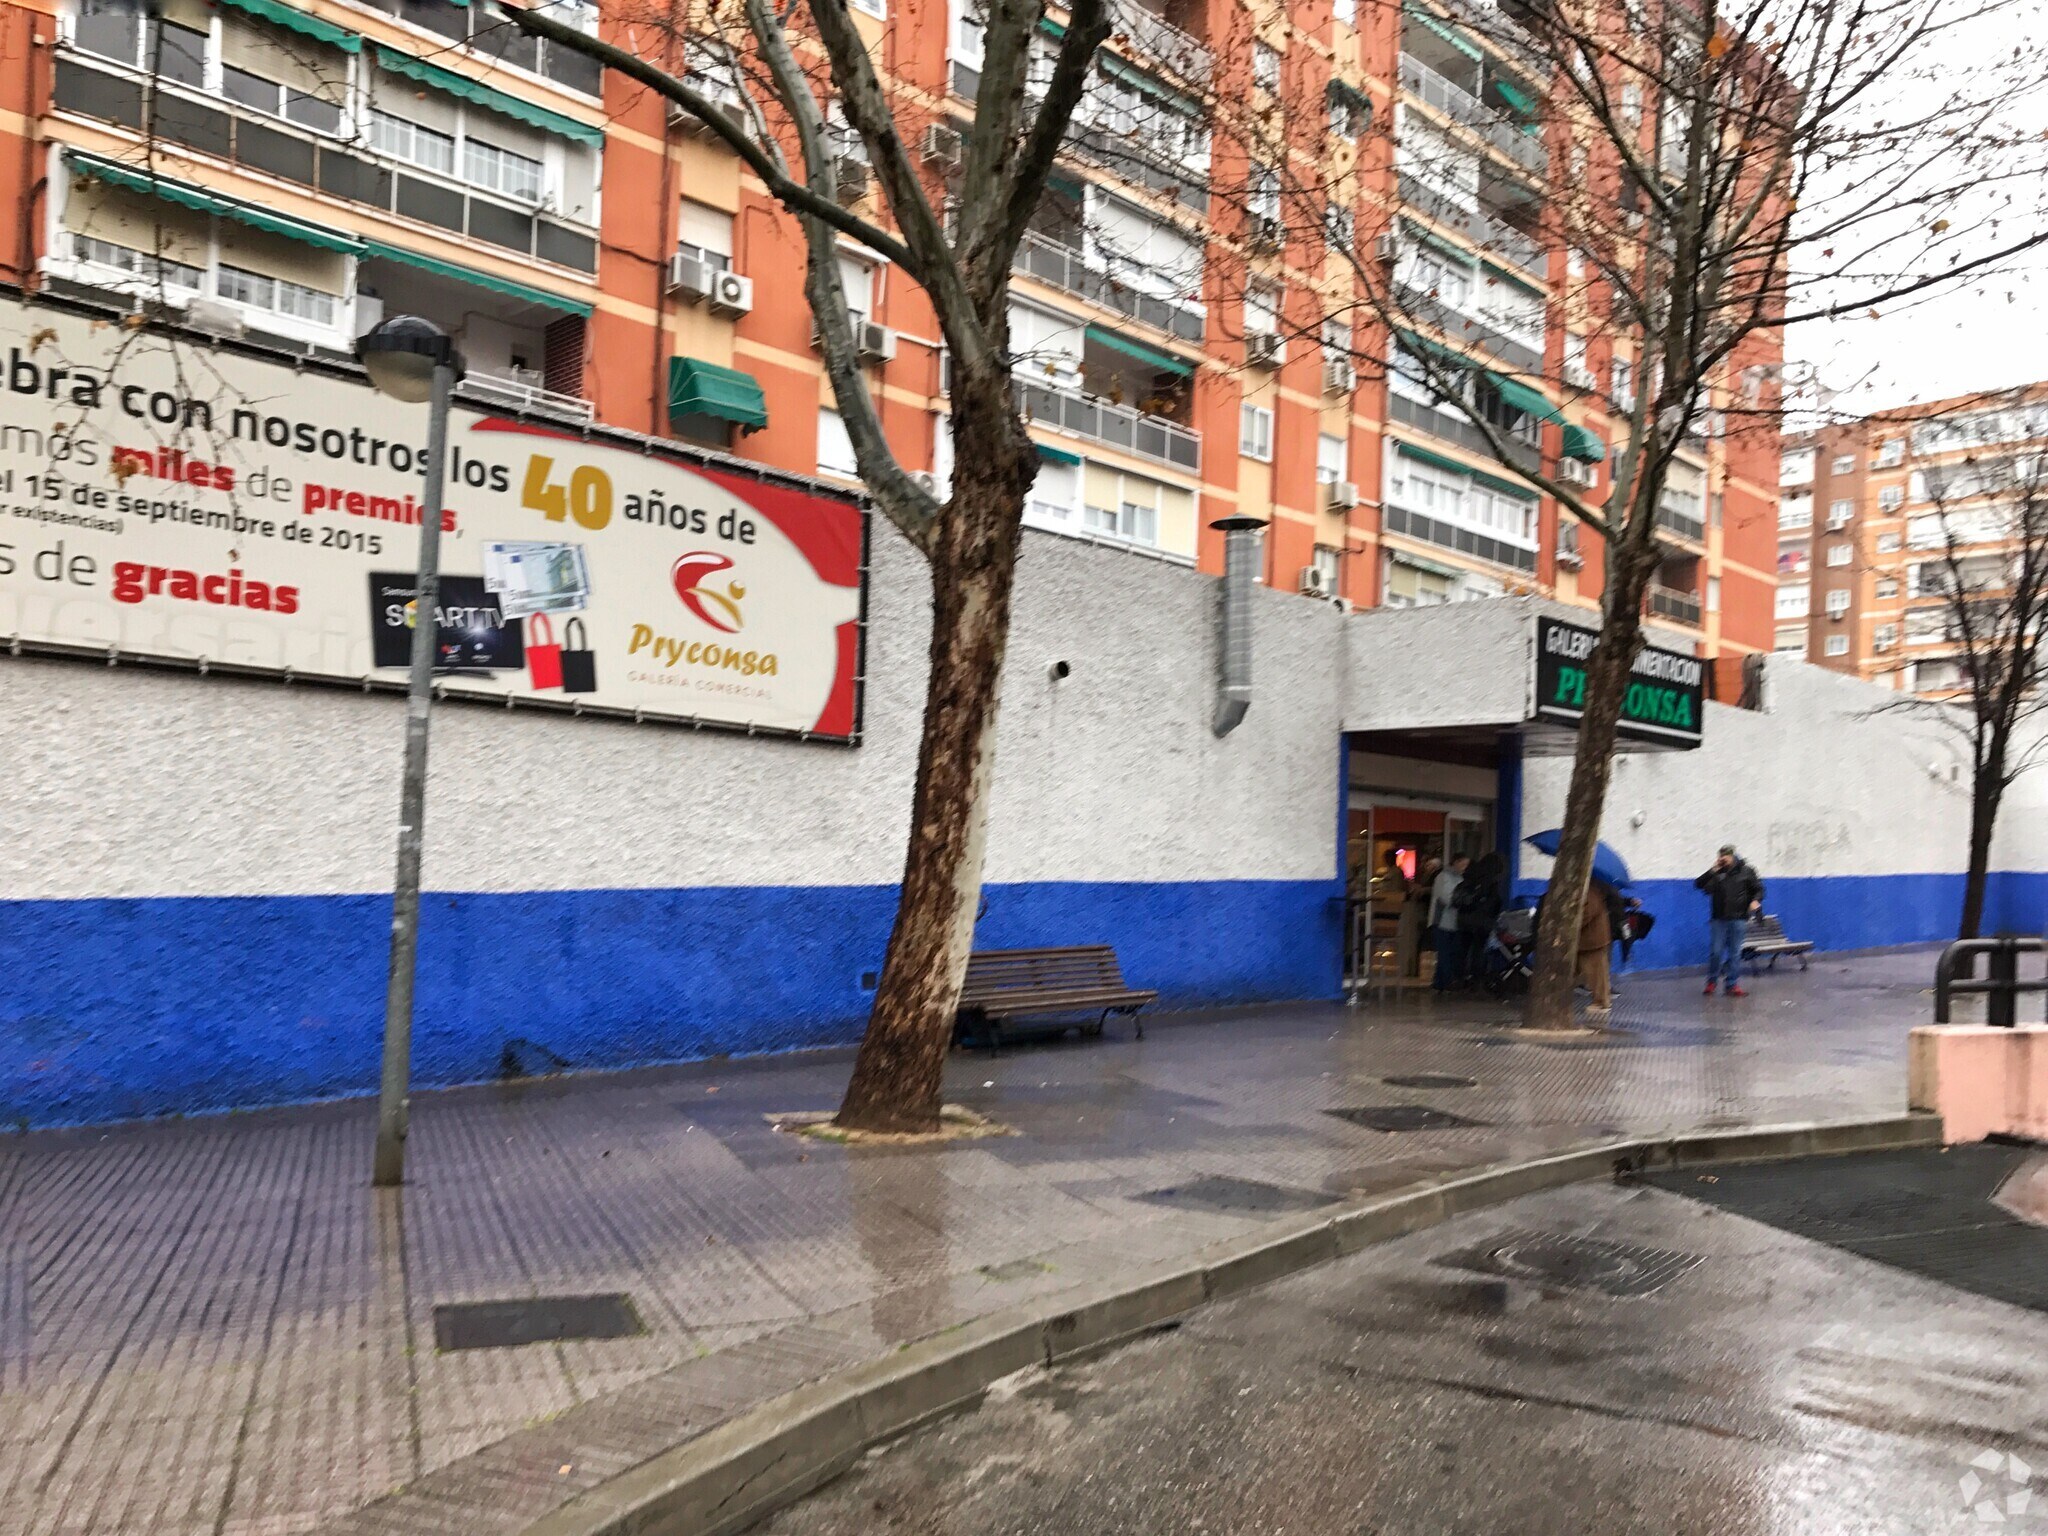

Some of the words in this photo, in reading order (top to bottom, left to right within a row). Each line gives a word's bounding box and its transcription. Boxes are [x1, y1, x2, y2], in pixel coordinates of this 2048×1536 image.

[0, 347, 101, 409] bra
[121, 384, 213, 432] con
[231, 407, 430, 477] nosotros
[451, 445, 510, 493] los
[521, 453, 613, 531] 40
[624, 489, 708, 535] años
[718, 508, 757, 545] de
[111, 445, 235, 491] miles
[246, 465, 292, 503] de
[25, 475, 64, 500] 15
[73, 482, 108, 508] de
[117, 495, 276, 538] septiembre
[282, 519, 314, 543] de
[320, 526, 383, 555] 2015
[34, 540, 98, 587] de
[110, 561, 300, 614] gracias
[385, 603, 480, 629] SART
[627, 623, 780, 677] Pryconsa
[694, 679, 774, 701] COMERCIAL
